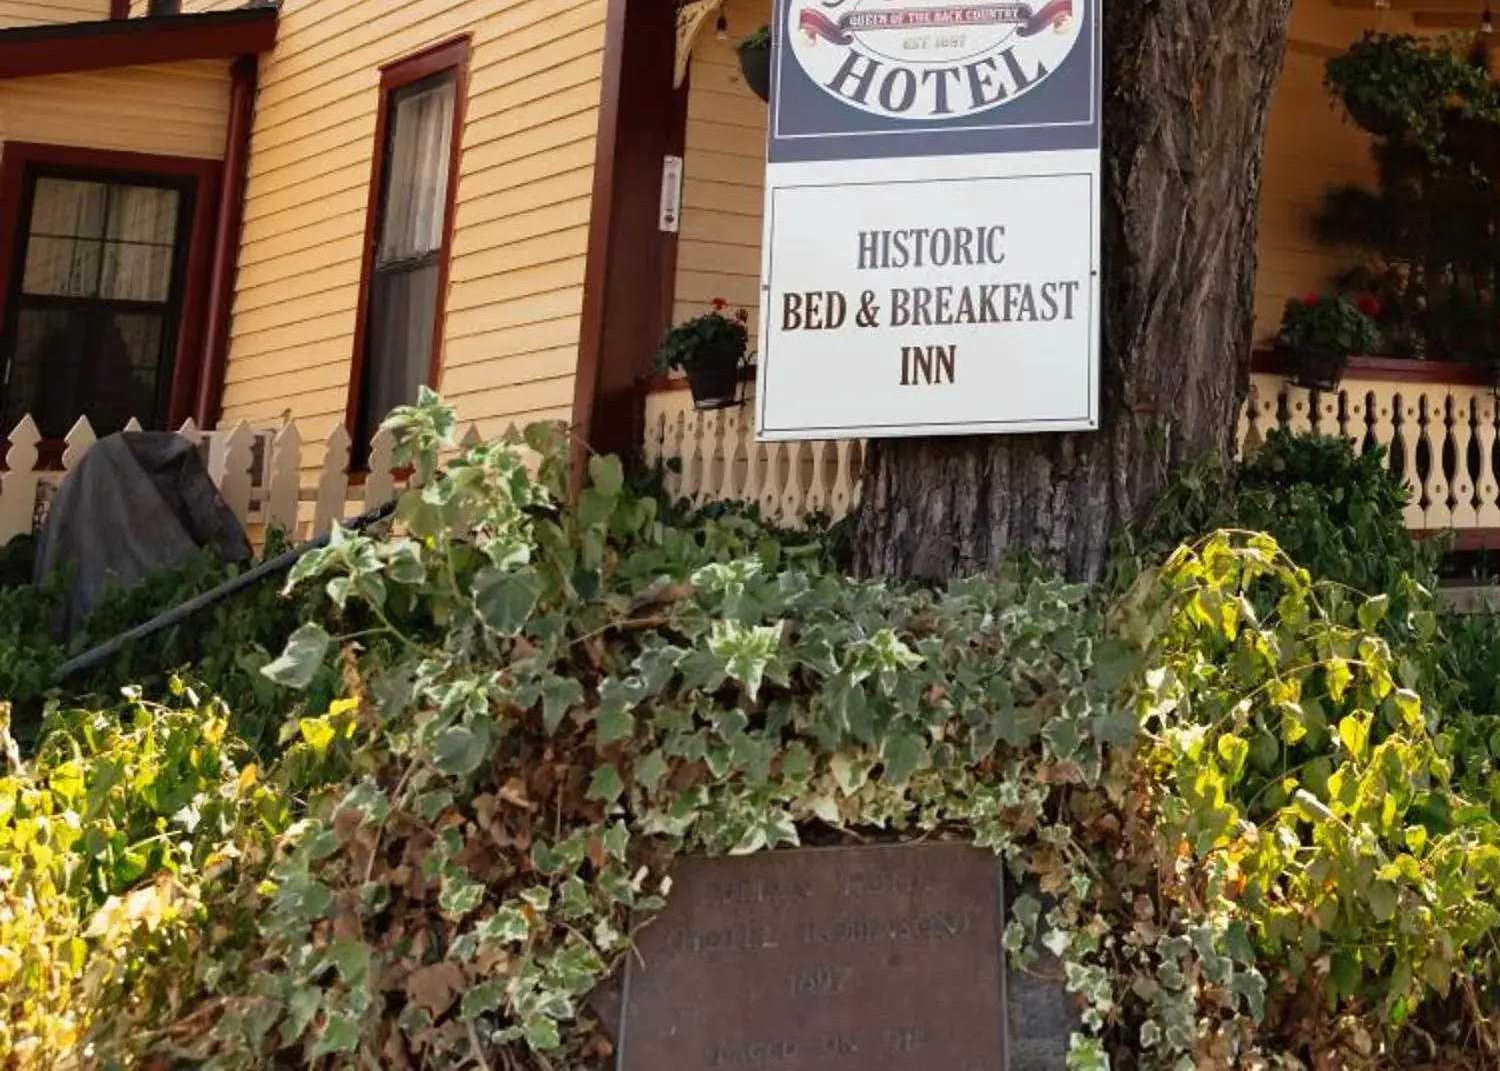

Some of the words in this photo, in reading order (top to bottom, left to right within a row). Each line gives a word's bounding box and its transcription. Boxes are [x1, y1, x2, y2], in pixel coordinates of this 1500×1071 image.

[824, 45, 1048, 115] HOTEL
[856, 225, 1006, 270] HISTORIC
[781, 290, 847, 332] BED
[855, 289, 881, 329] &
[889, 280, 1080, 328] BREAKFAST
[899, 344, 958, 387] INN
